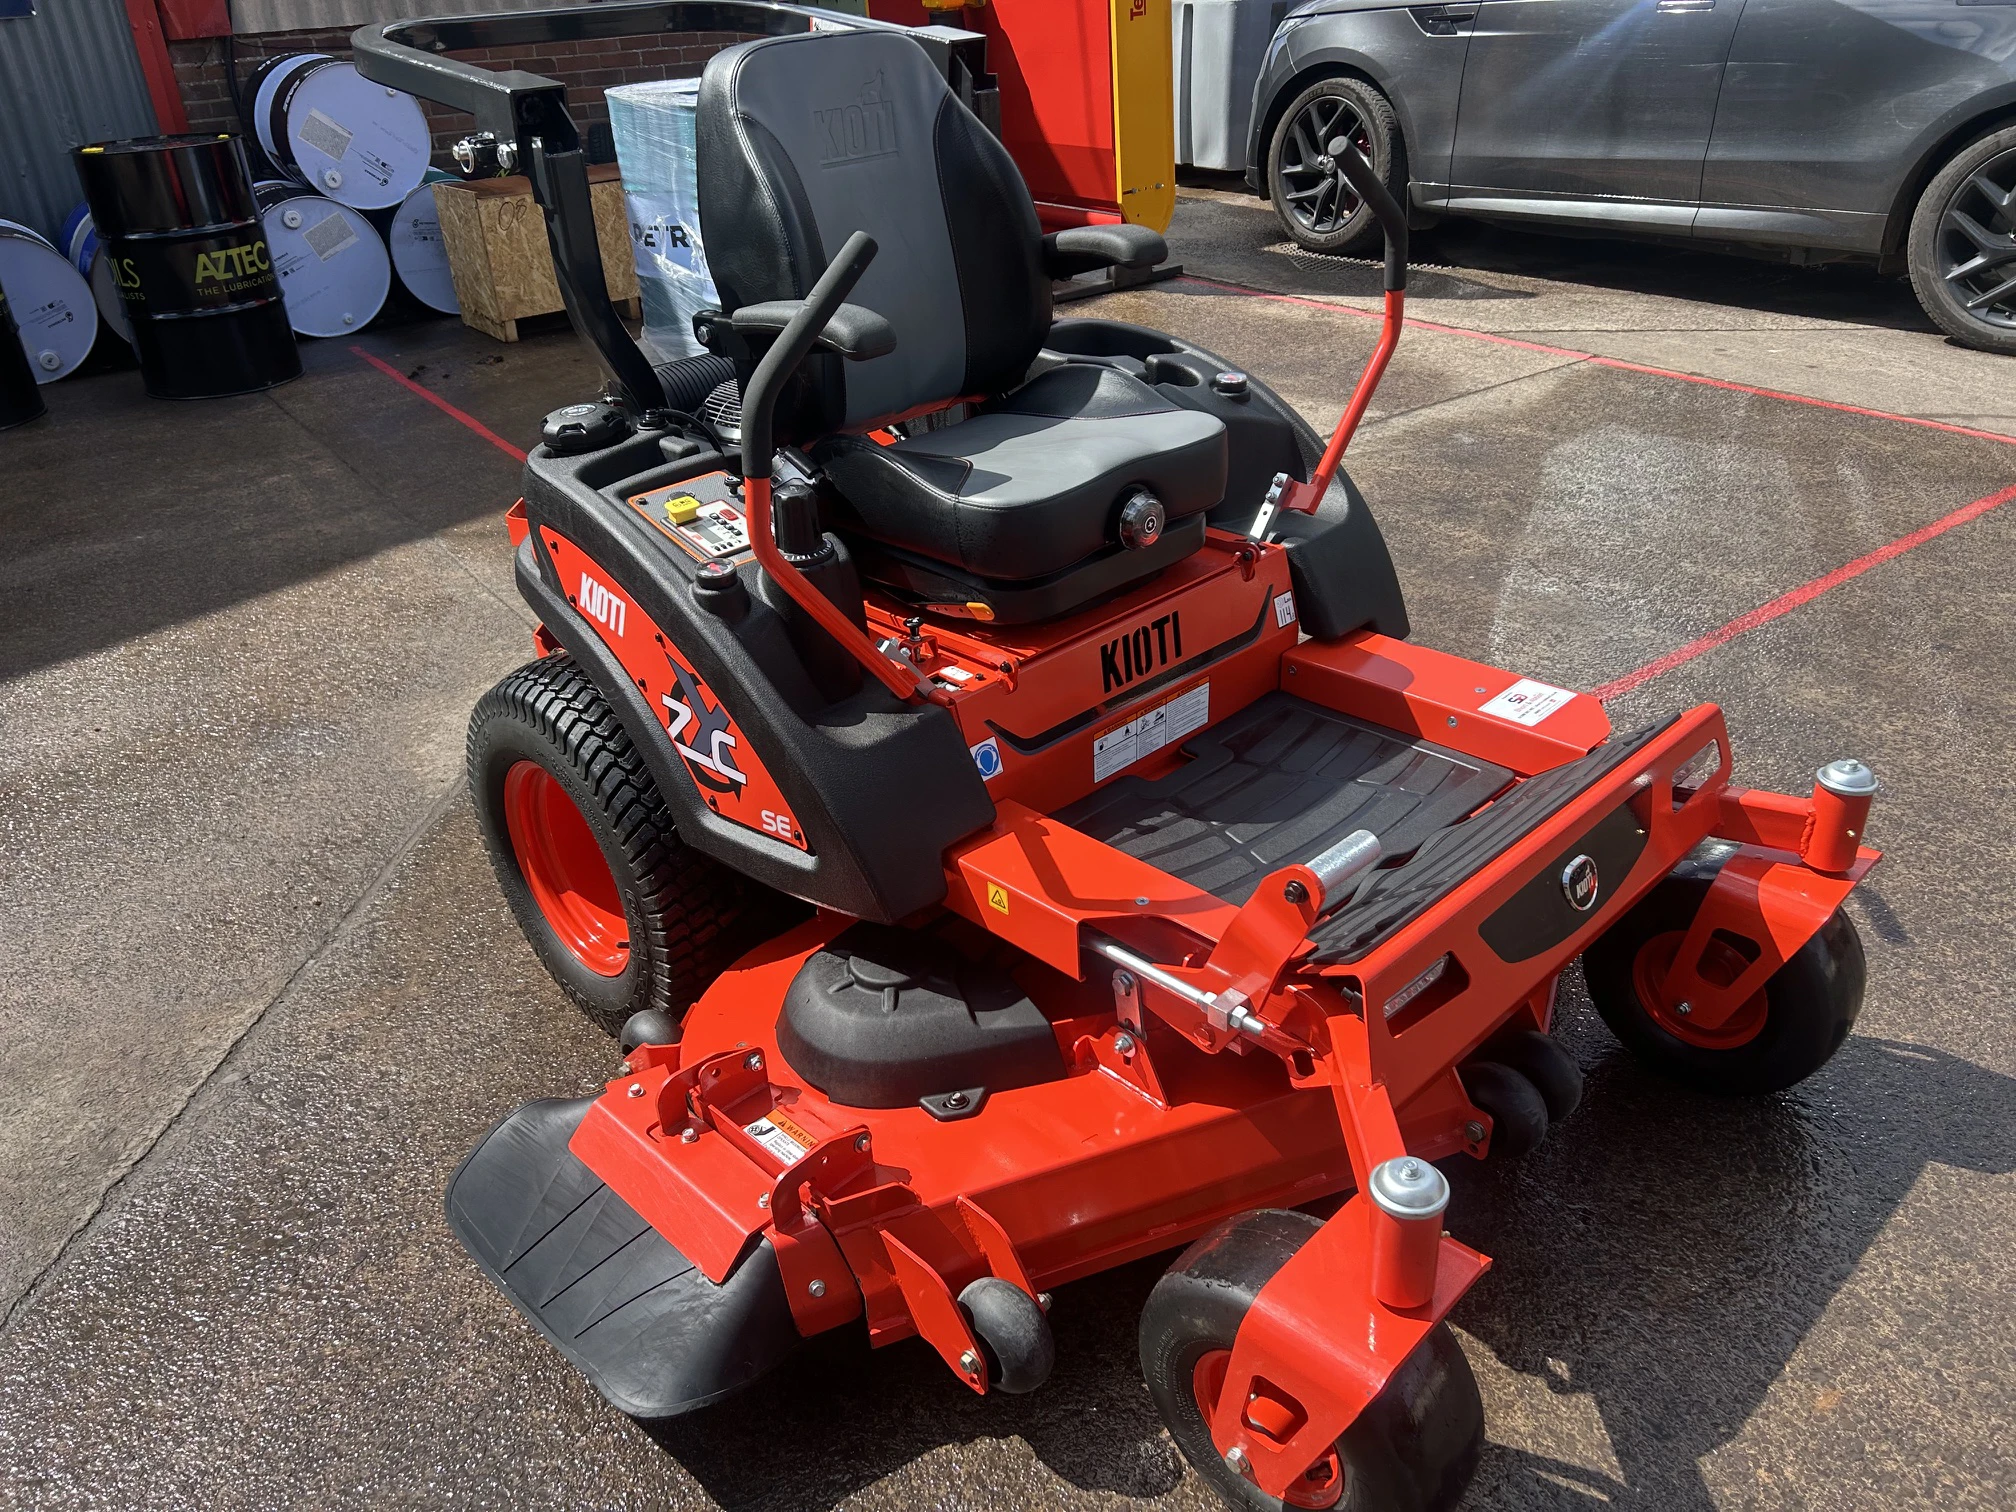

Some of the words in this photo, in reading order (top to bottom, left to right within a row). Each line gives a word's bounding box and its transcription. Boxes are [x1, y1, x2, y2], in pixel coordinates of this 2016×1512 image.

[813, 100, 898, 160] KIOTI
[194, 240, 270, 284] AZTEC
[196, 286, 220, 297] THE
[579, 571, 627, 638] KIOTI
[1100, 610, 1183, 694] KIOTI
[760, 809, 792, 838] SE
[1576, 871, 1594, 899] KIOTI
